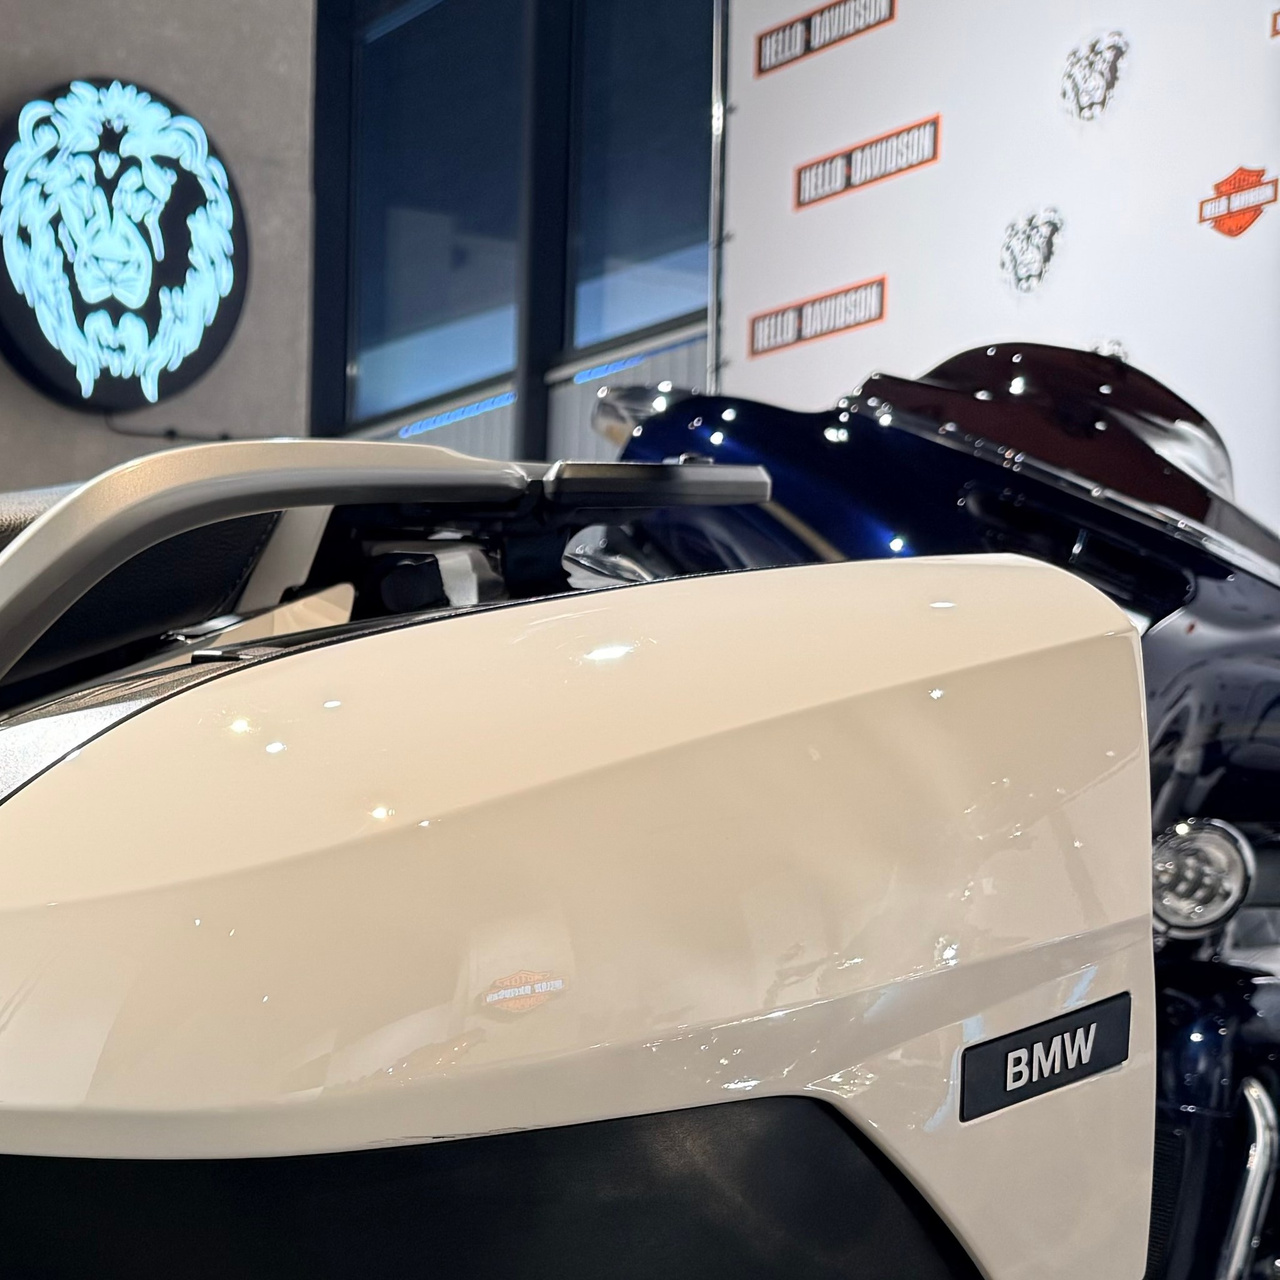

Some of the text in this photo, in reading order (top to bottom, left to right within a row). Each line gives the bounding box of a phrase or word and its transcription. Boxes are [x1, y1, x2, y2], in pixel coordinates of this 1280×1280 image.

[761, 20, 805, 71] HELLO
[800, 122, 935, 203] HELLO DAVIDSON
[754, 282, 881, 352] HELLO DAVIDSON
[1006, 1023, 1096, 1091] BMW
